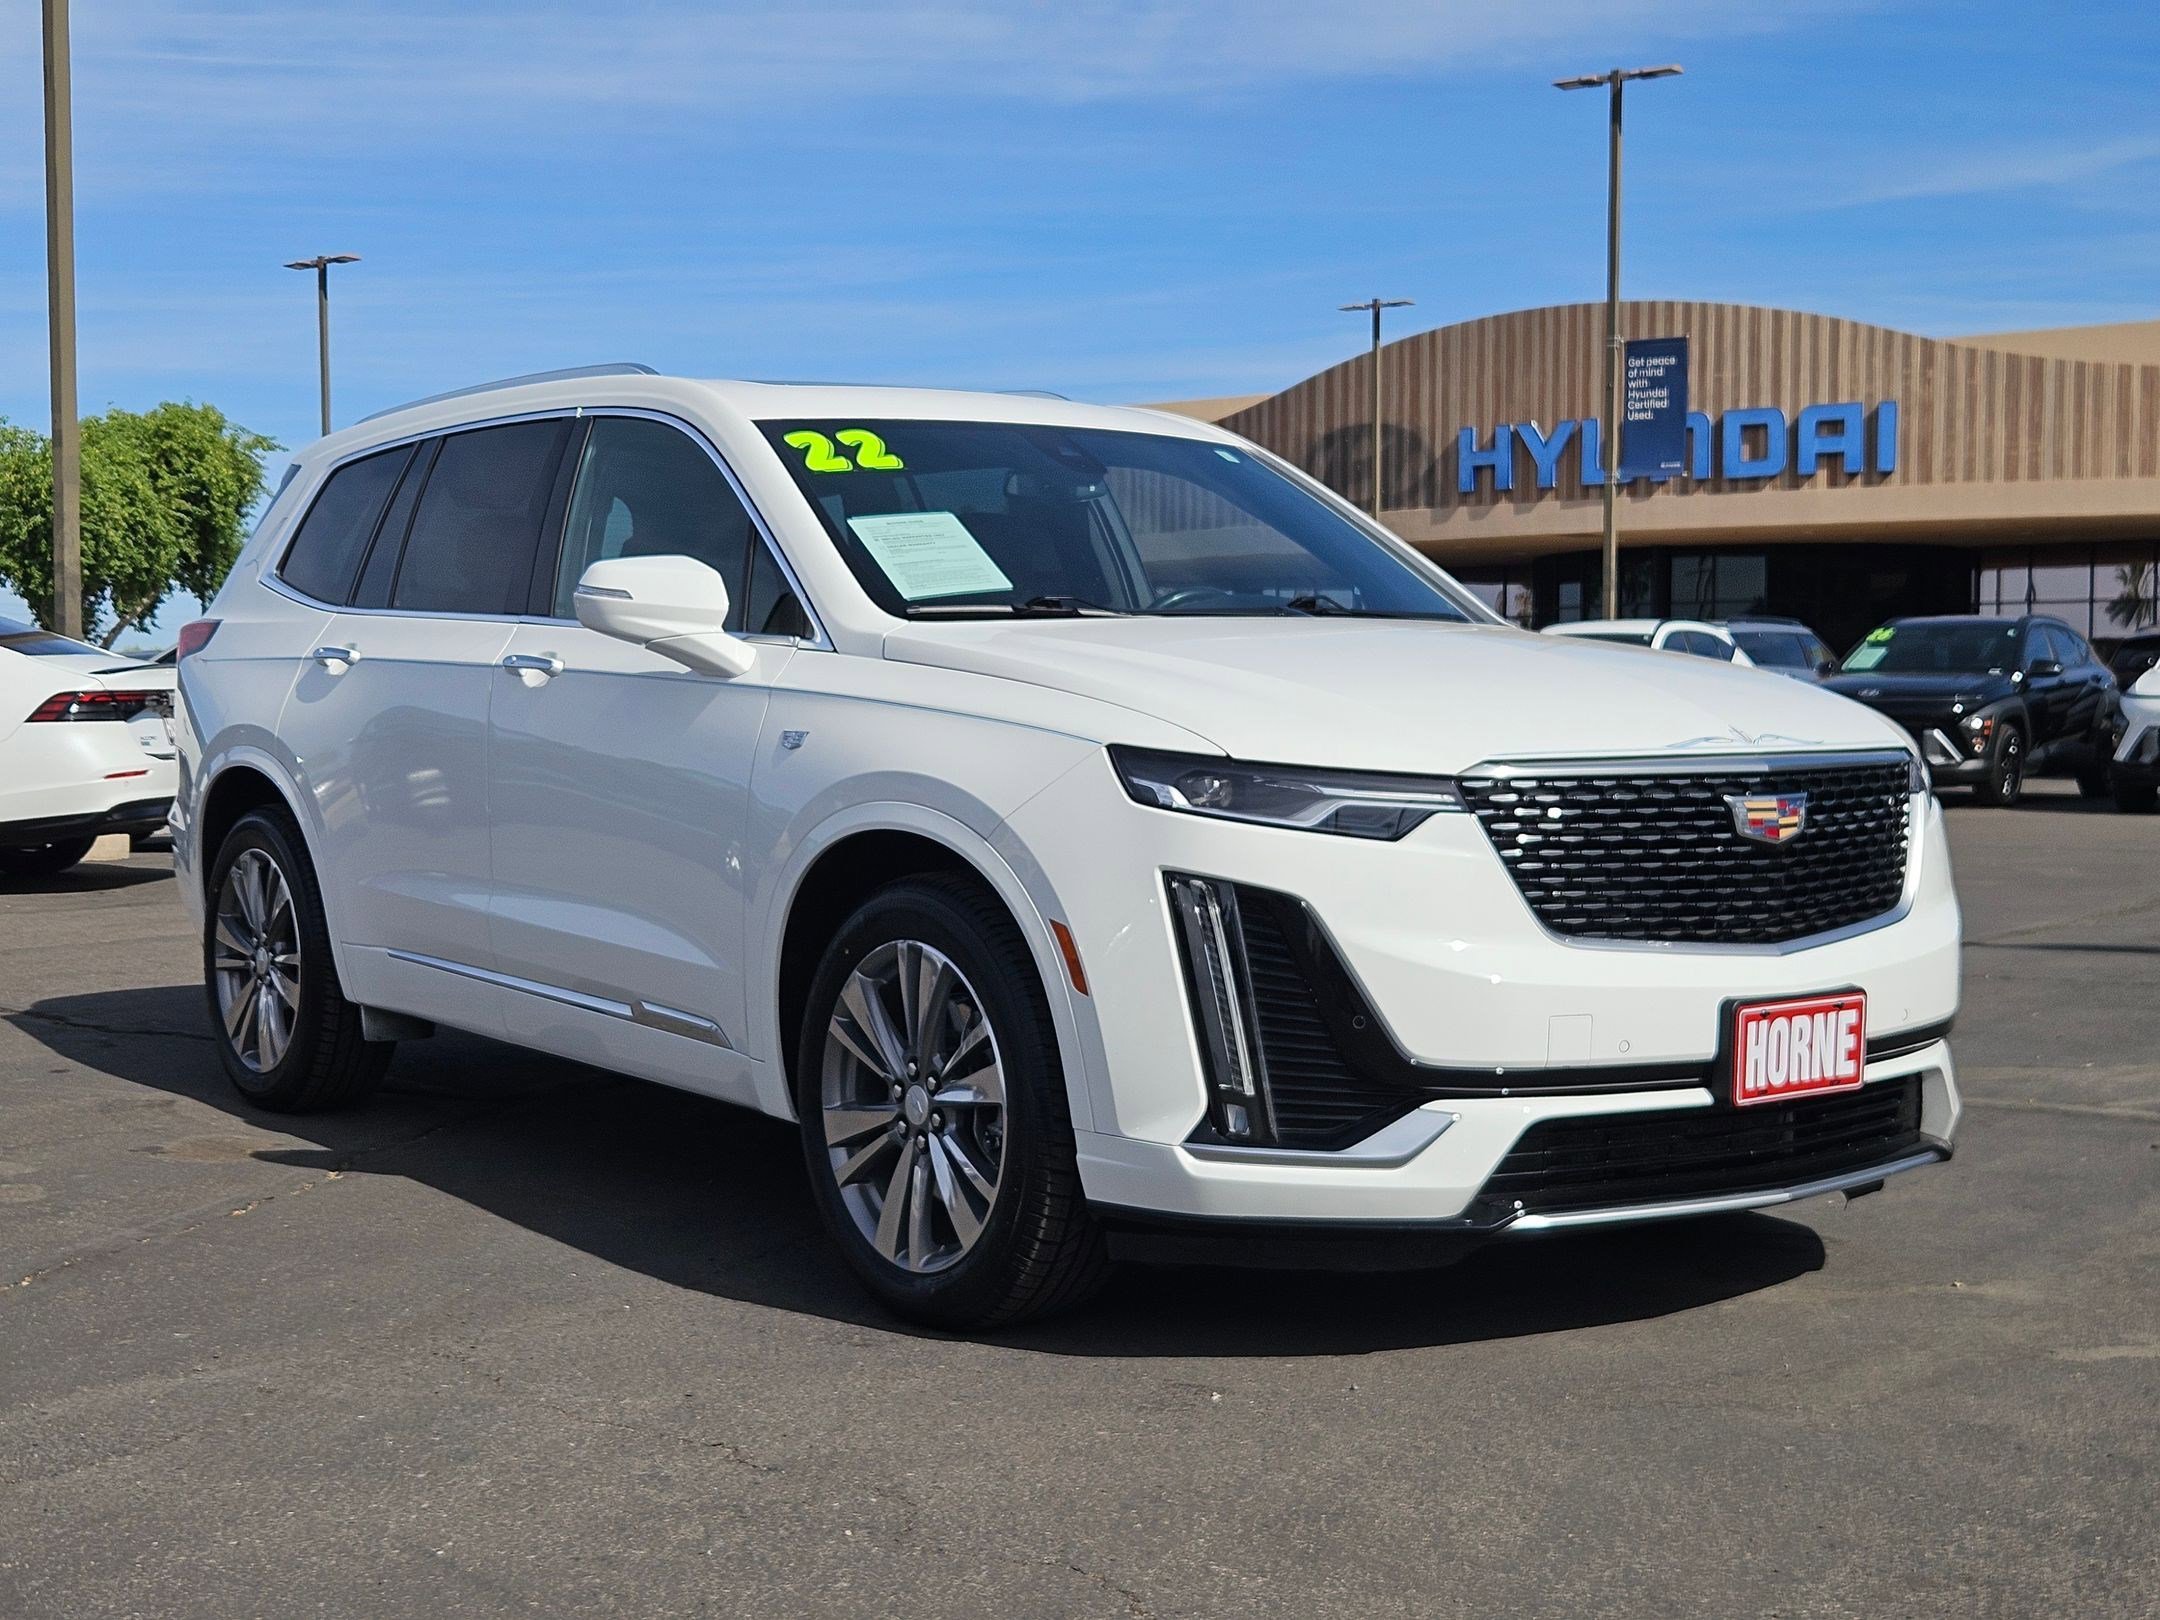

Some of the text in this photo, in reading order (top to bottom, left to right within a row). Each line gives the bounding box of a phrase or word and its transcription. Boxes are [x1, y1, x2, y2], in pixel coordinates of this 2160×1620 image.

[1628, 356, 1676, 368] Get peace
[1628, 366, 1663, 378] of mind
[1628, 378, 1648, 388] with
[1628, 386, 1667, 400] Hyundai
[1628, 398, 1667, 410] Certified
[784, 429, 904, 472] 22
[1745, 1010, 1858, 1090] HORNE
